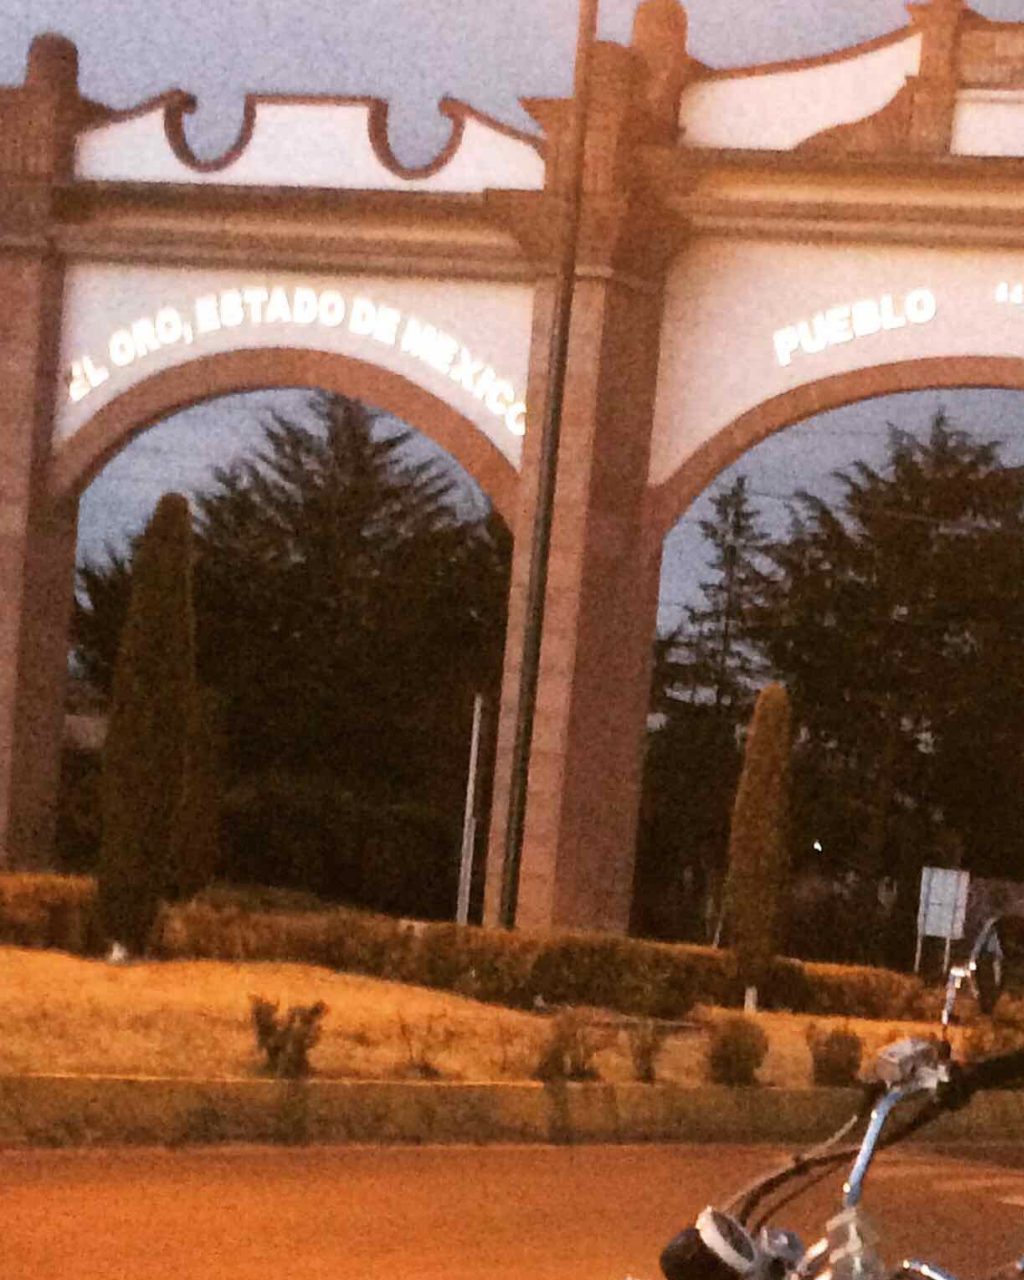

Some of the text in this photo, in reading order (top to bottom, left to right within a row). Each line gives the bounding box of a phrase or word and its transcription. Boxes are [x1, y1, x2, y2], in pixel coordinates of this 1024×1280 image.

[109, 305, 194, 368] ORO,
[194, 287, 345, 333] ESTADO
[347, 296, 402, 346] DE
[773, 288, 936, 366] PUEBLO
